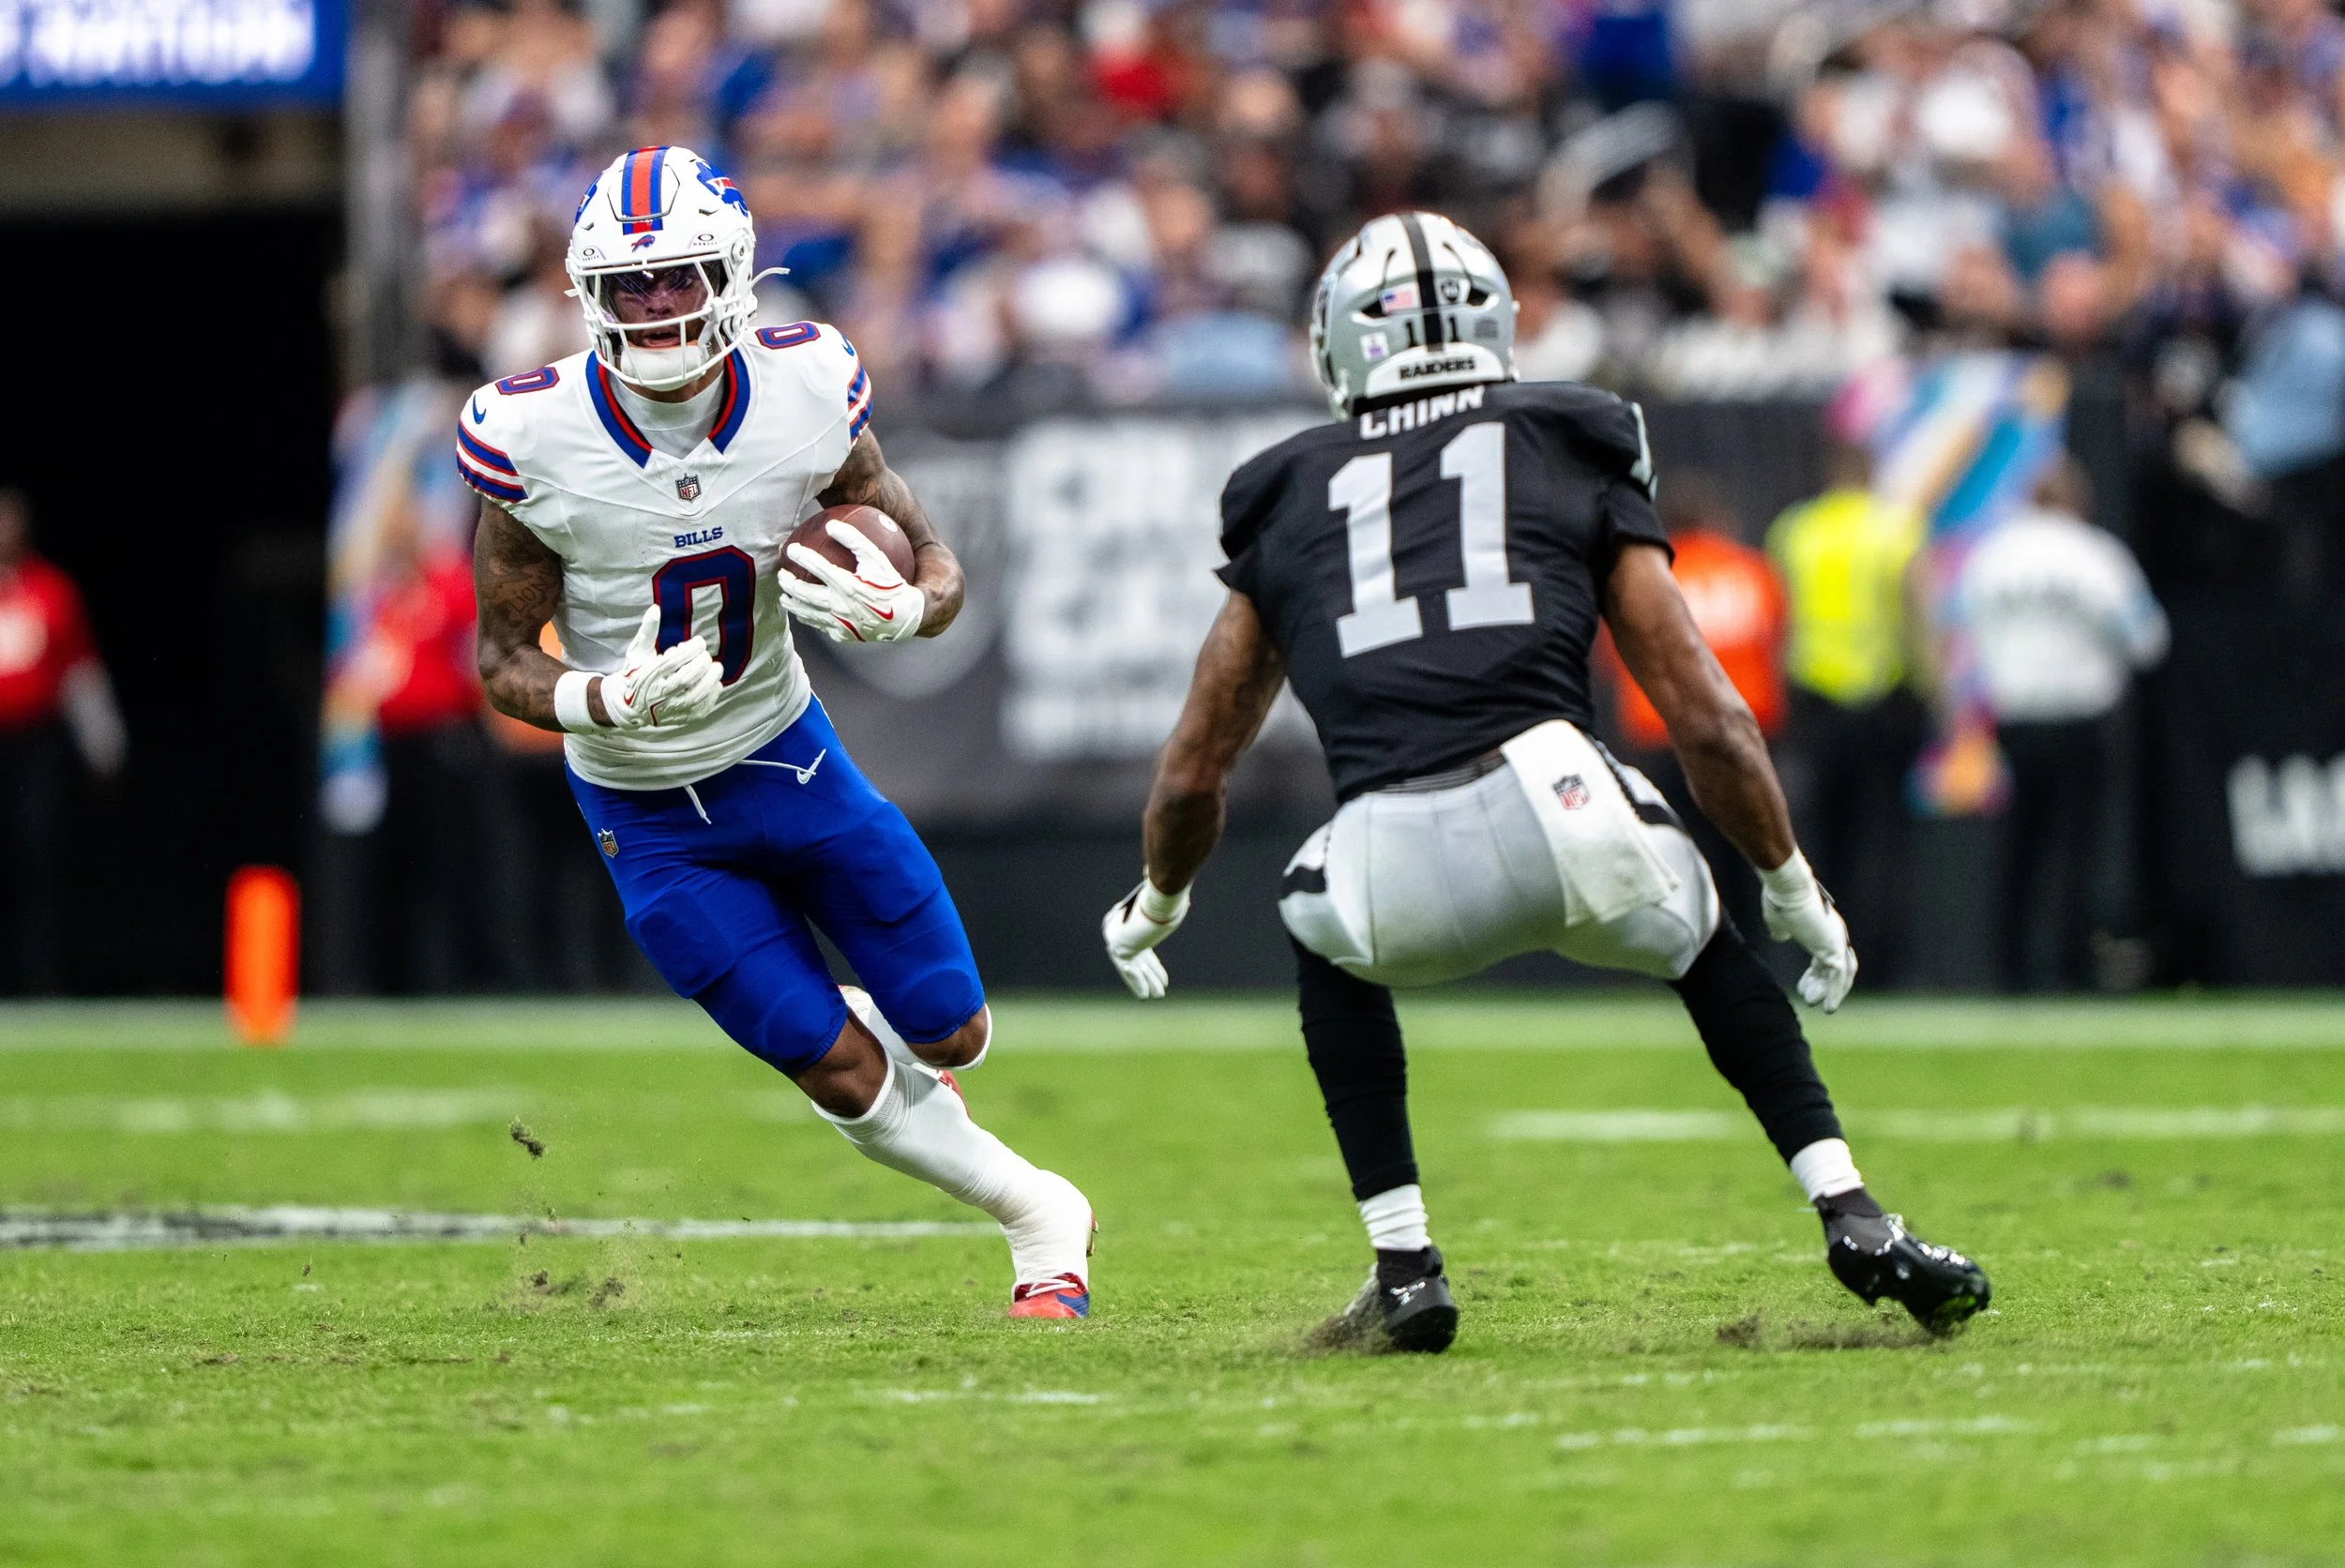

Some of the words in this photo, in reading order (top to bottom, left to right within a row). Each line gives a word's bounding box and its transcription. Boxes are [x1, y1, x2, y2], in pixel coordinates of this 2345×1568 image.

[755, 322, 821, 350] 0
[495, 367, 560, 396] 0
[1399, 356, 1475, 381] RAIDERS
[1360, 384, 1486, 441] CHINN
[680, 485, 699, 500] NFL
[673, 526, 723, 549] BILLS
[1327, 421, 1536, 658] 11
[652, 545, 756, 687] 0
